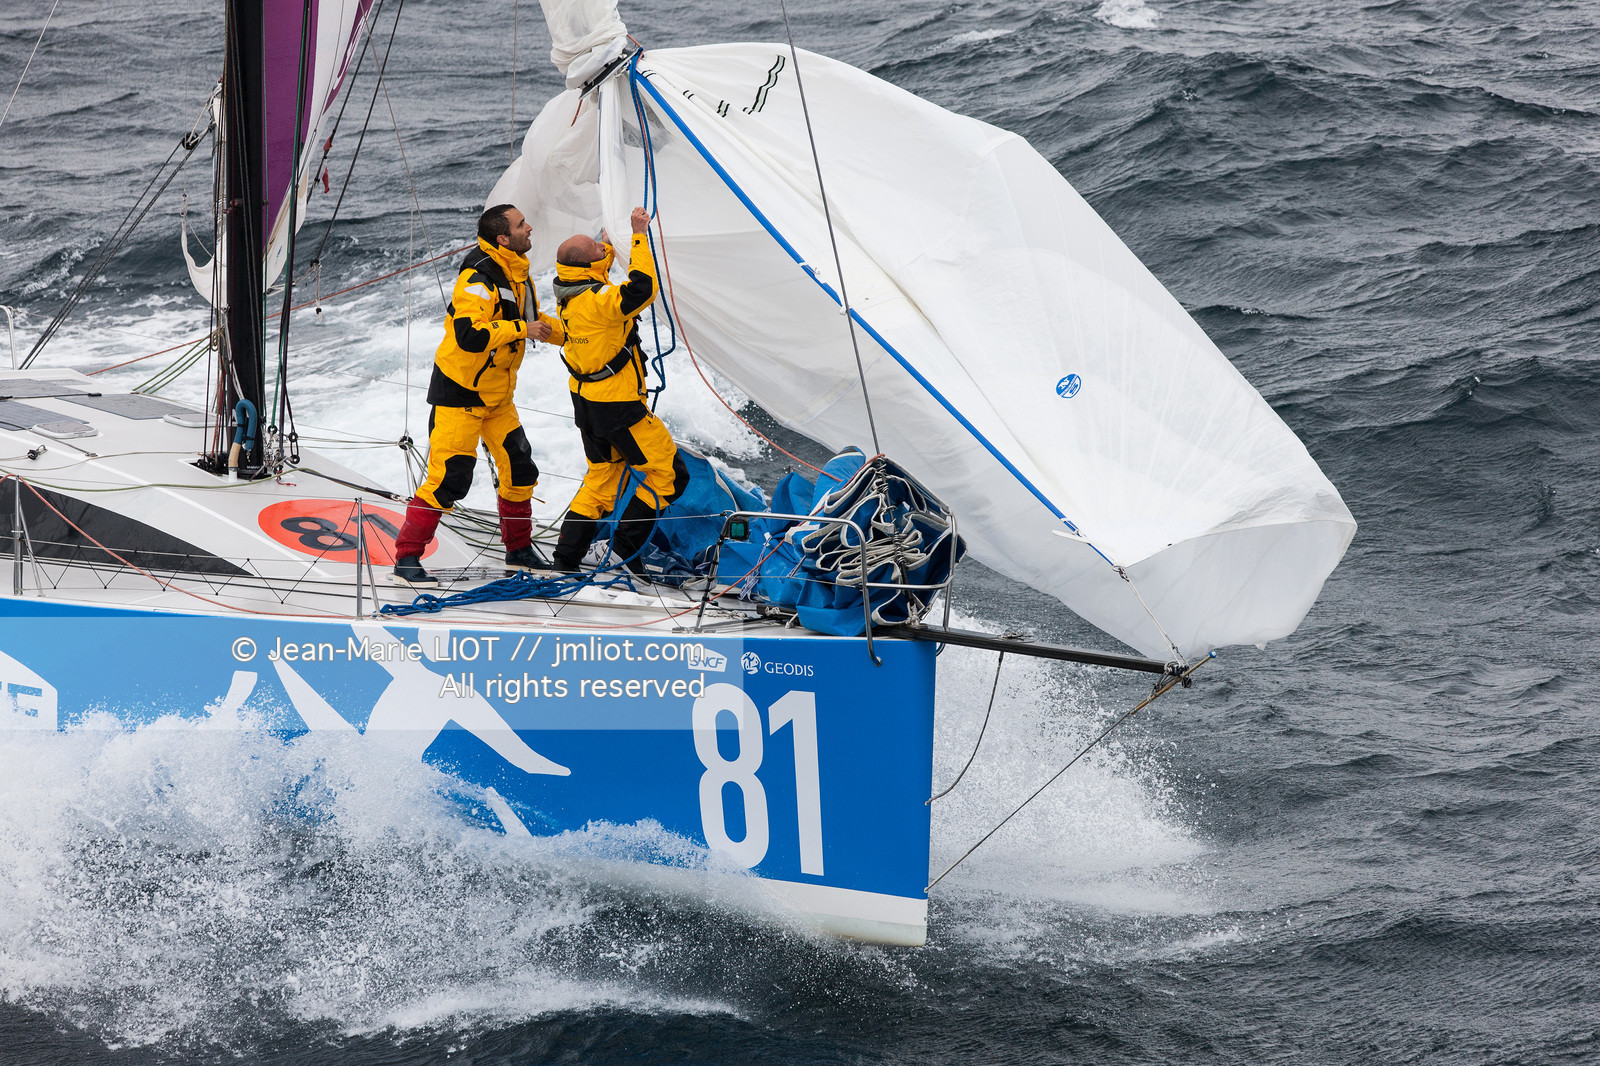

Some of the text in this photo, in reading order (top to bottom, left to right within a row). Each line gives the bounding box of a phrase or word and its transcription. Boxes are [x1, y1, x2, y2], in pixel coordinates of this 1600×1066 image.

[690, 655, 725, 669] SNCF
[764, 661, 814, 677] GEODIS
[692, 682, 825, 876] 81
